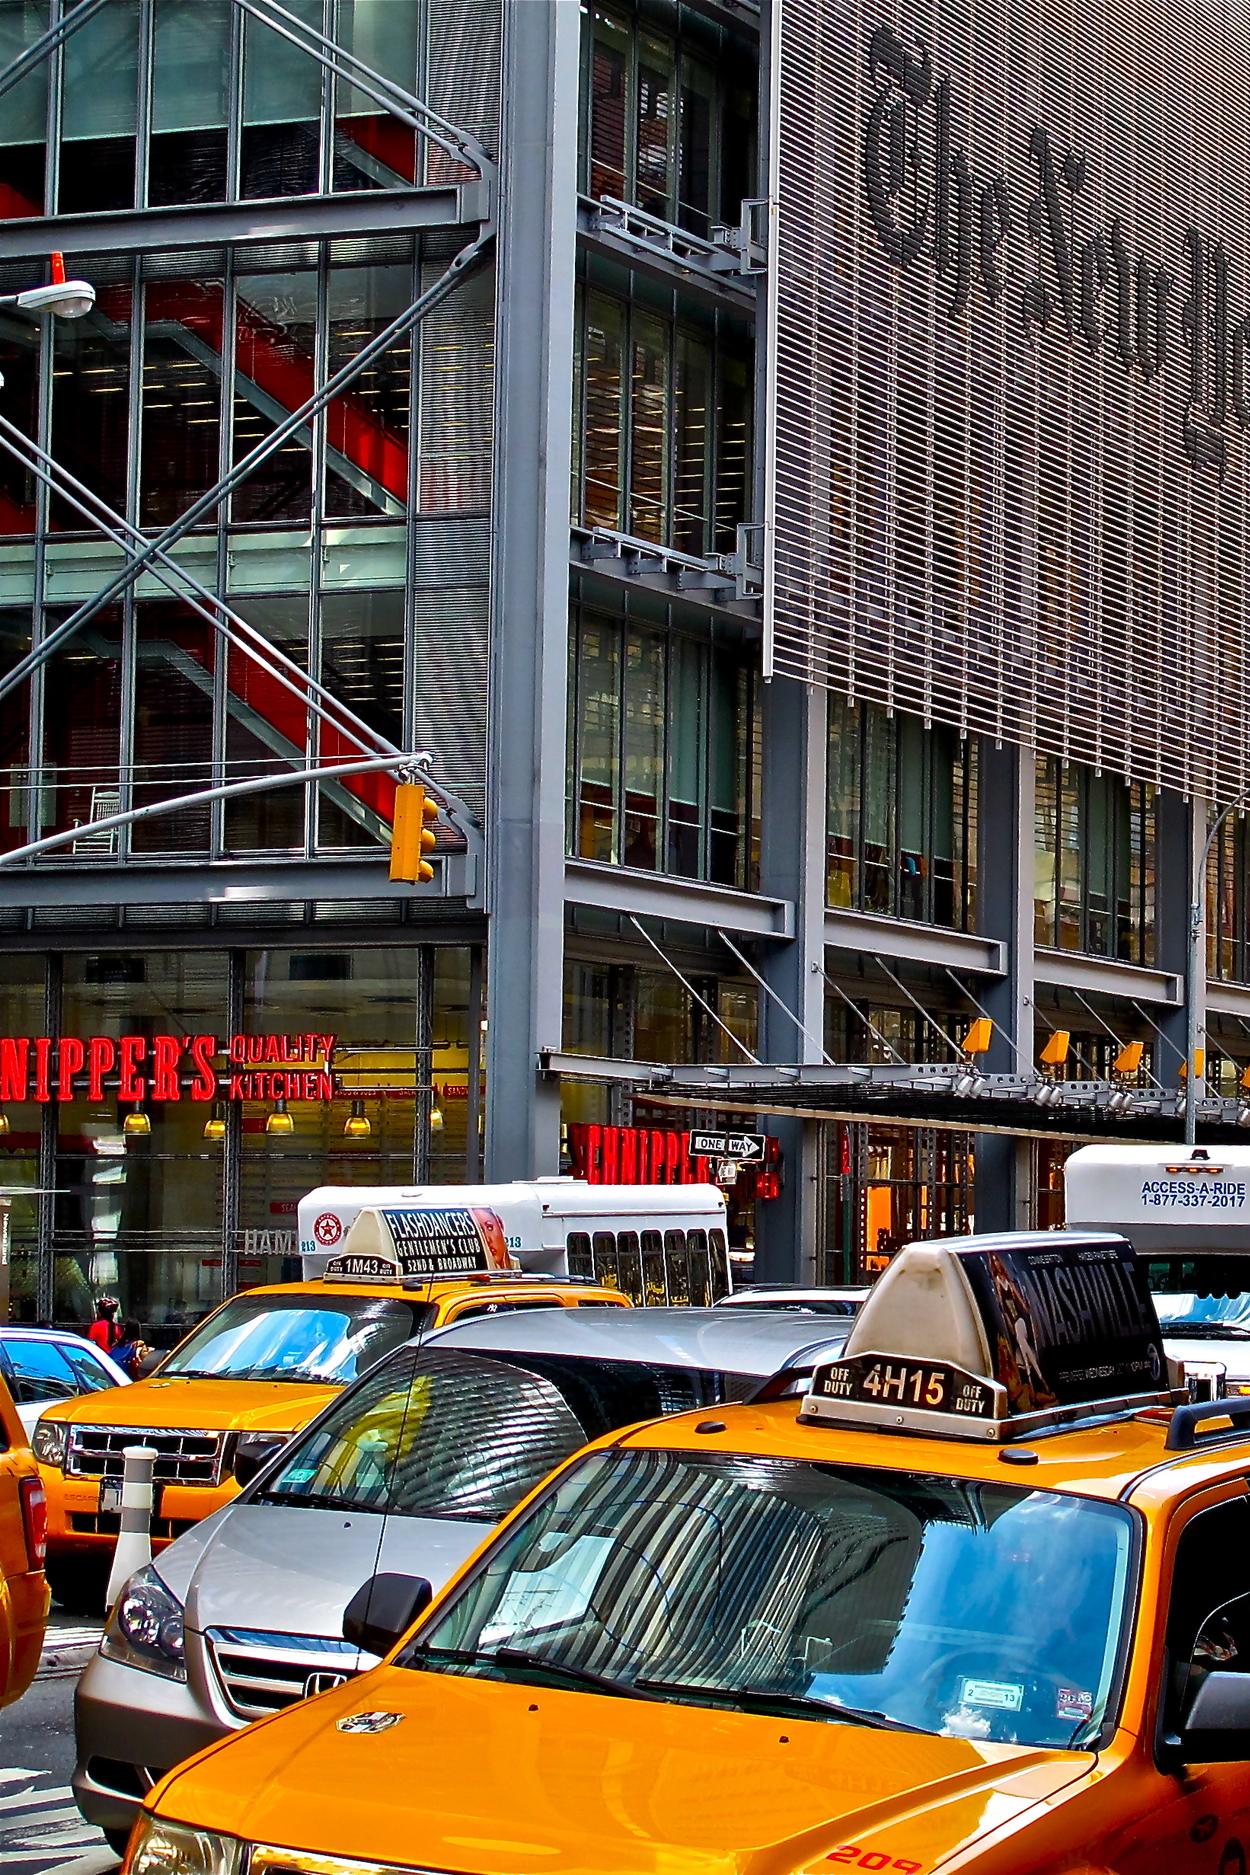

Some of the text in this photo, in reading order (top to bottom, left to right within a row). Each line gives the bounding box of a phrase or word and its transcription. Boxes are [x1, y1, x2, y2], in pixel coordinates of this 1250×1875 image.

[866, 25, 1011, 317] The
[1022, 126, 1173, 383] New
[230, 1034, 338, 1064] QUALITY
[0, 1035, 218, 1101] NIPPER'S
[229, 1072, 336, 1101] KITCHEN
[701, 1139, 752, 1152] ONE WAY
[1141, 1181, 1246, 1195] ACCESS-A-RIDE
[1141, 1194, 1245, 1208] 1-877-337-2017
[385, 1211, 476, 1239] FLASHDANCERS
[396, 1238, 481, 1257] GENTLEMEN'S CLUB
[345, 1258, 378, 1274] 1M43
[408, 1256, 477, 1272] 52ND & BROADWAY
[1022, 1261, 1154, 1347] NASHVILLE
[830, 1366, 850, 1382] OFF
[823, 1379, 853, 1396] DUTY
[862, 1364, 946, 1406] 4H15
[963, 1385, 982, 1400] OFF
[956, 1397, 986, 1414] DUTY
[967, 1689, 1015, 1702] 2 13
[825, 1844, 923, 1875] 209
